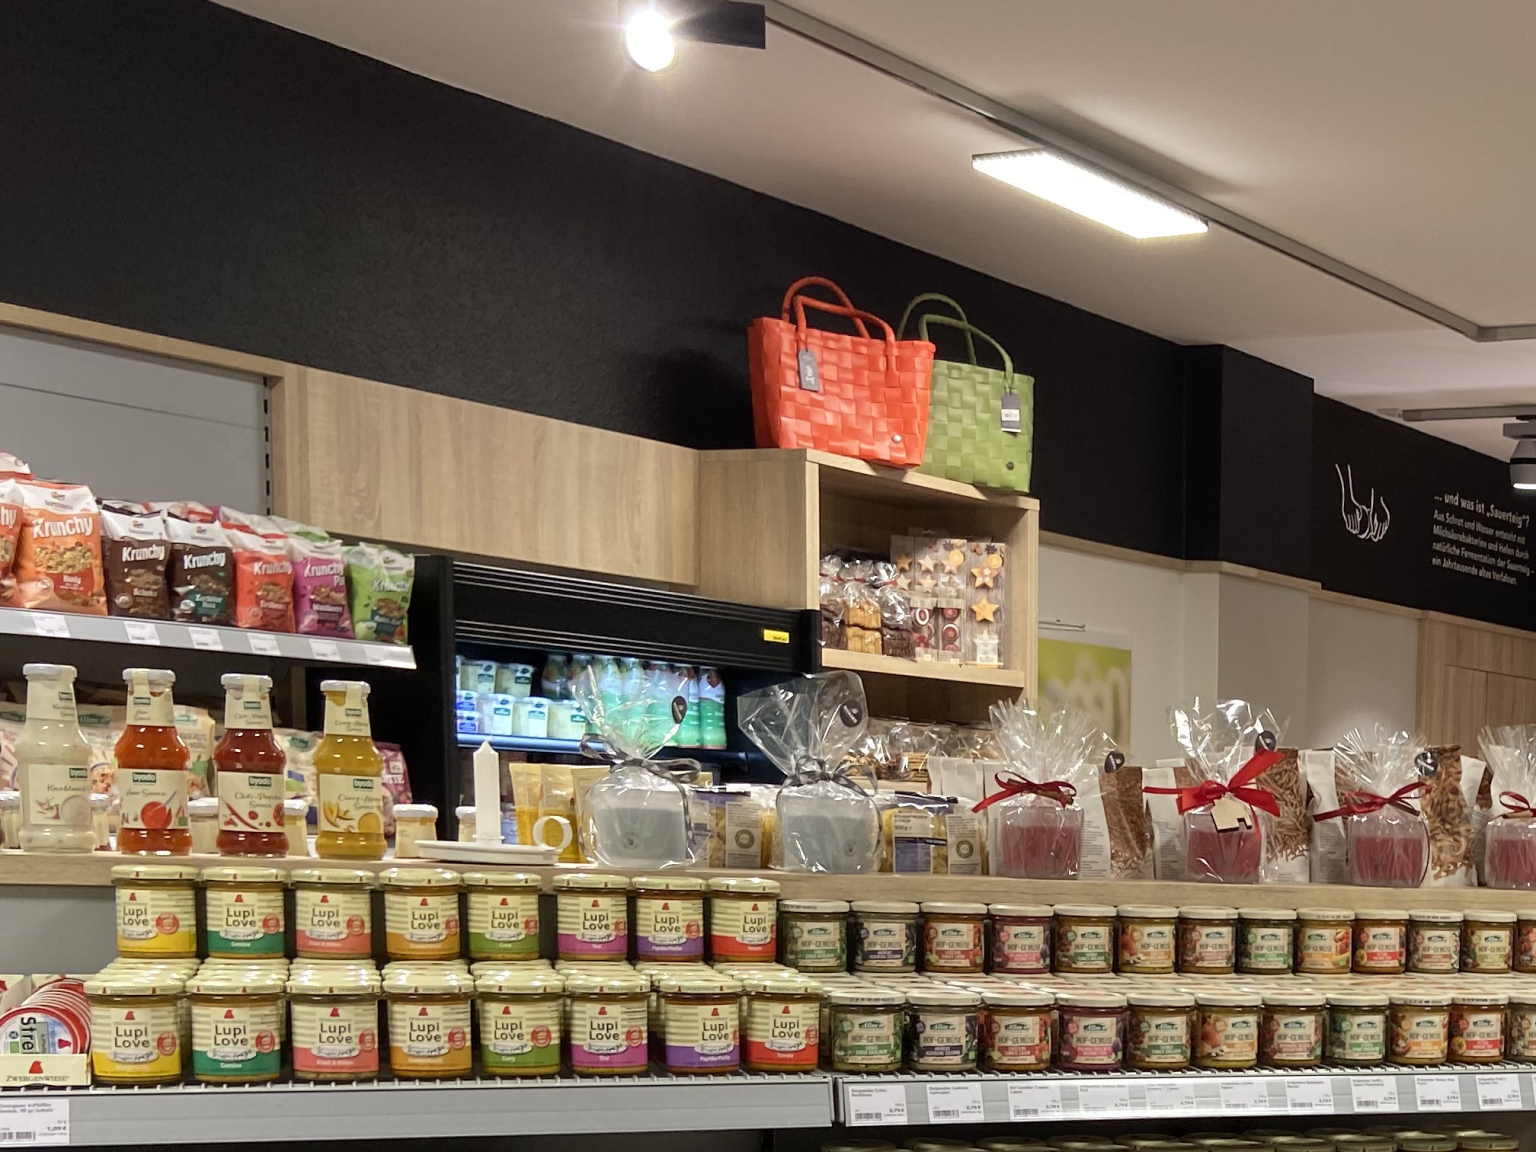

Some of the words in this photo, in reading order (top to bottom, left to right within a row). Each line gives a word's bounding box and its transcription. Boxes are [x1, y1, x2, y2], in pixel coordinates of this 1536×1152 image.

[1444, 493, 1459, 506] und
[1460, 498, 1474, 511] was
[1475, 500, 1485, 514] ist
[33, 515, 94, 539] Krunchy
[122, 544, 165, 562] Krunchy
[184, 551, 226, 569] Krunchy
[214, 1024, 247, 1038] Lupi
[320, 1023, 351, 1036] Lupi
[409, 1021, 440, 1034] Lupi
[494, 1019, 523, 1033] Lupi
[589, 1020, 618, 1033] Lupi
[702, 1021, 728, 1034] Lupi
[772, 1019, 799, 1032] Lupi
[20, 1017, 37, 1054] Stre
[115, 1026, 149, 1039] Lupi
[318, 1033, 353, 1045] Love
[408, 1032, 442, 1043] Love
[493, 1030, 525, 1041] Love
[588, 1031, 620, 1041] Love
[701, 1031, 730, 1041] Love
[771, 1029, 801, 1040] Love
[114, 1037, 150, 1049] Love
[213, 1035, 248, 1047] Love
